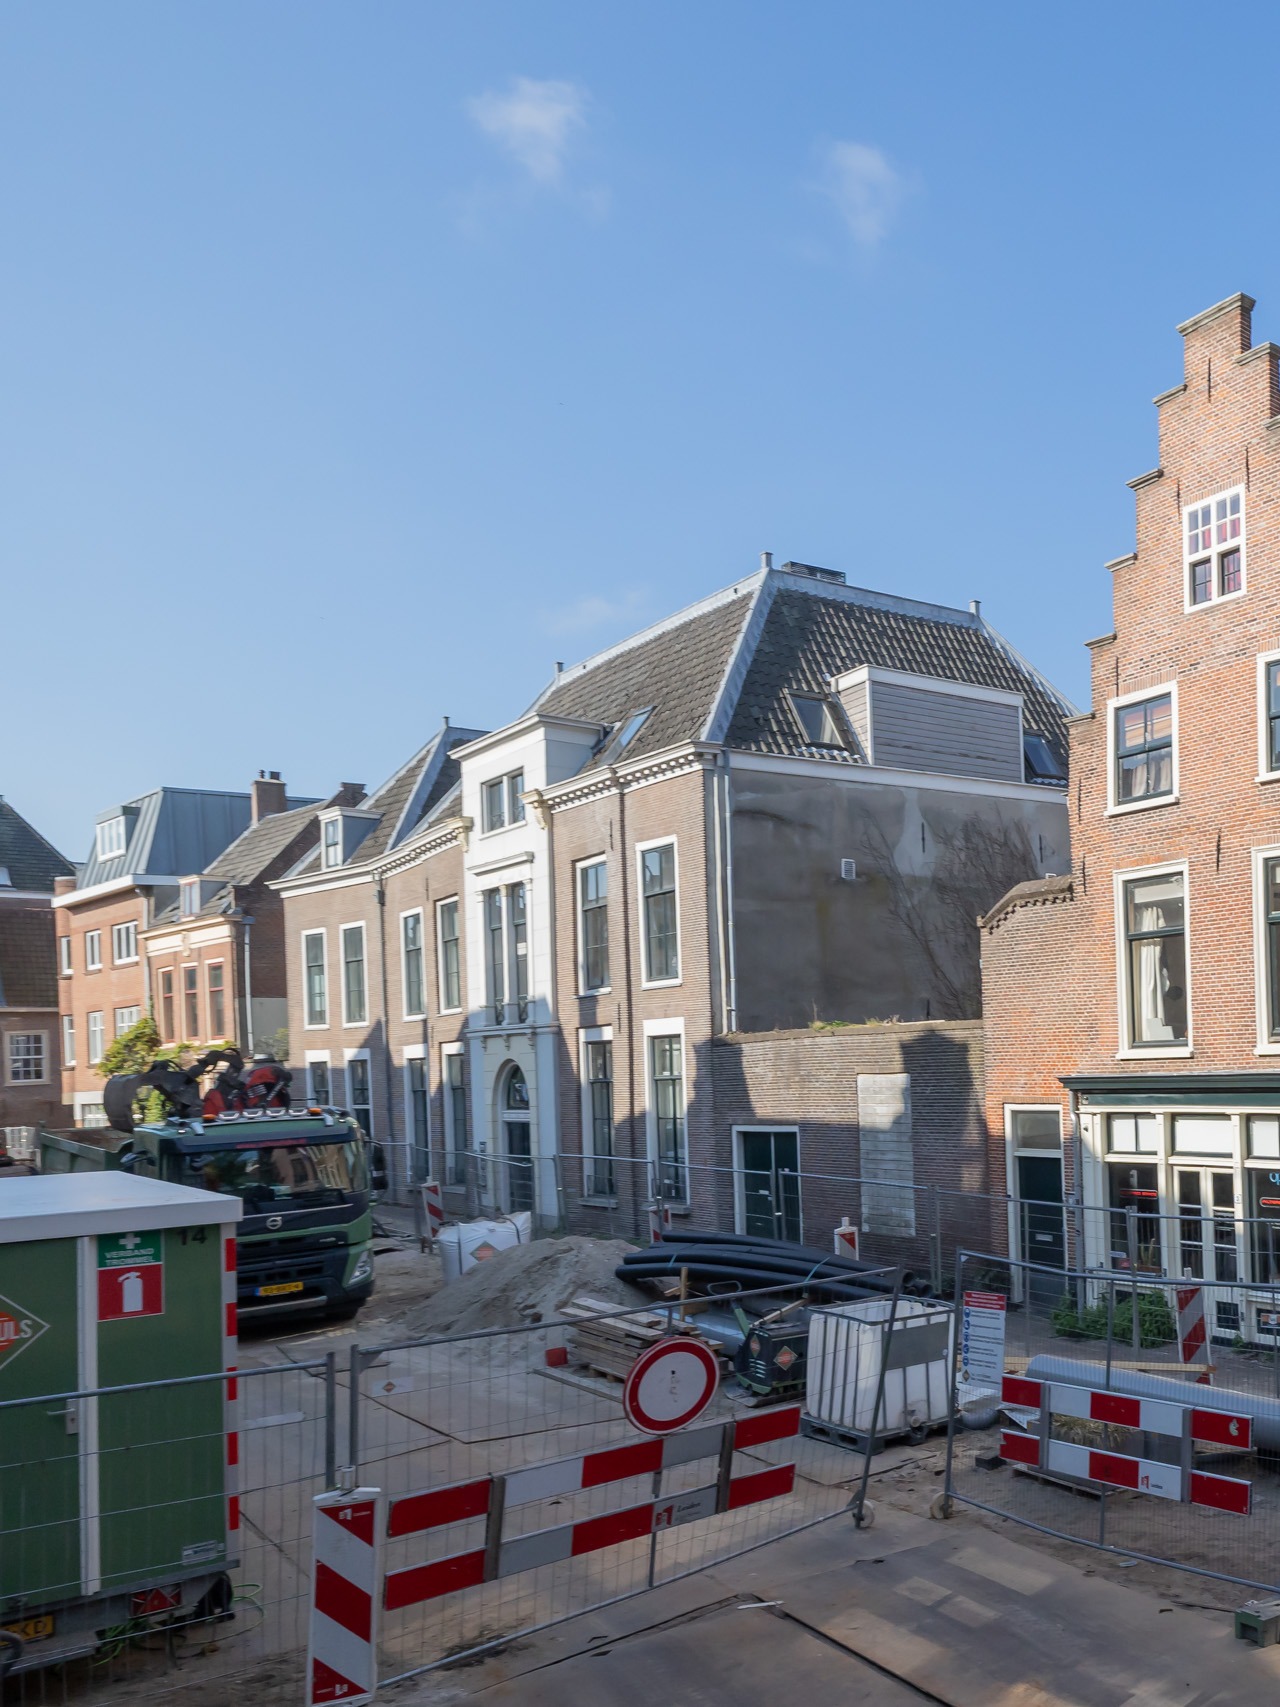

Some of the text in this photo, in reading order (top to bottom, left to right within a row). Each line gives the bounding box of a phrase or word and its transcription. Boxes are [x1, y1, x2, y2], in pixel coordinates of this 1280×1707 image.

[176, 1227, 208, 1246] 14
[104, 1248, 155, 1259] VERBAND
[104, 1256, 156, 1266] TROMMEL
